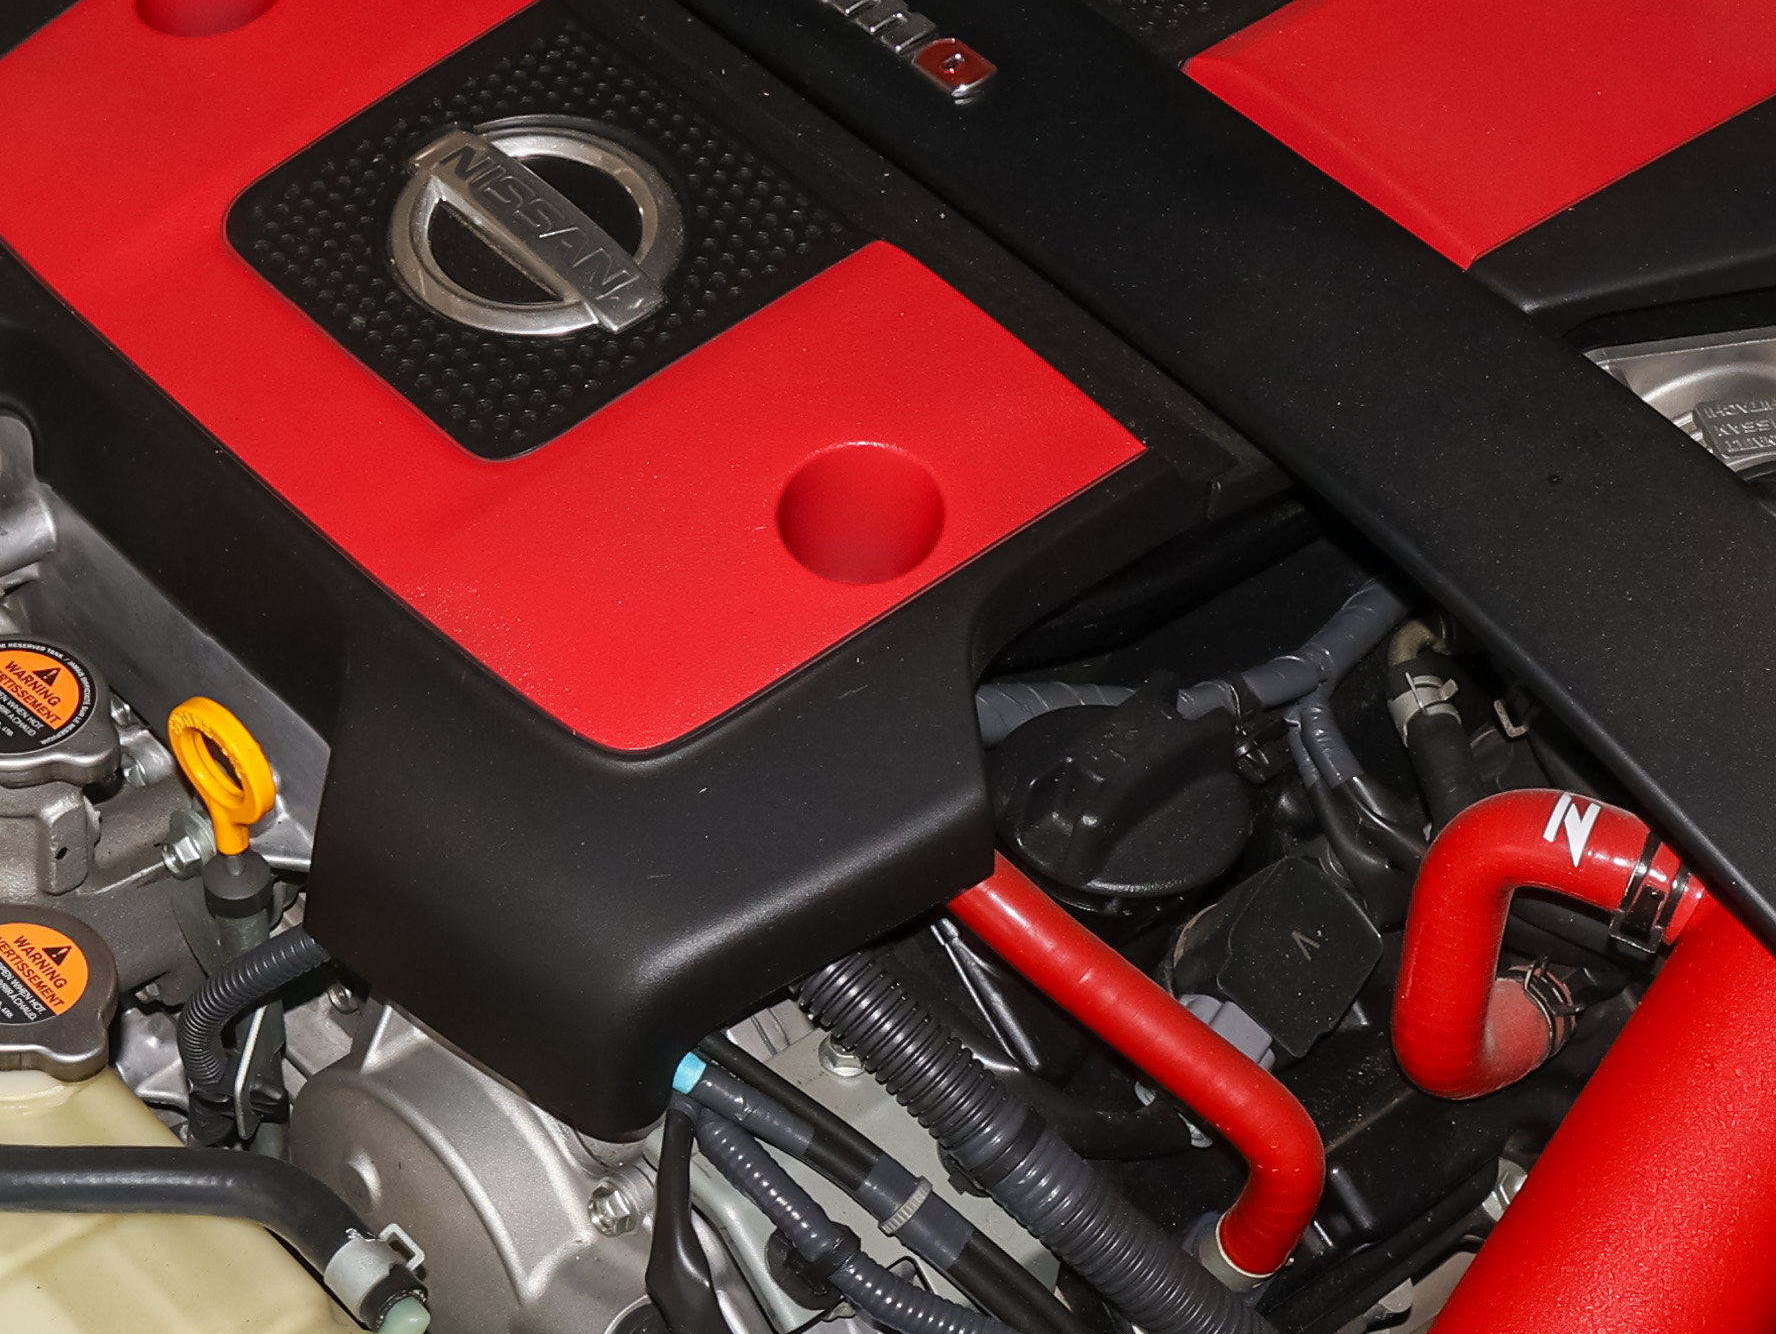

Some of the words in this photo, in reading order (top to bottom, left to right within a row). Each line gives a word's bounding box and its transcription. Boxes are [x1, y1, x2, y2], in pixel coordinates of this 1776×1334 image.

[439, 146, 641, 303] NISSAN
[45, 648, 65, 657] TANK
[5, 661, 61, 707] WARNING
[6, 698, 29, 719] WHEN
[14, 935, 67, 989] WARNING
[10, 978, 32, 999] WHEN
